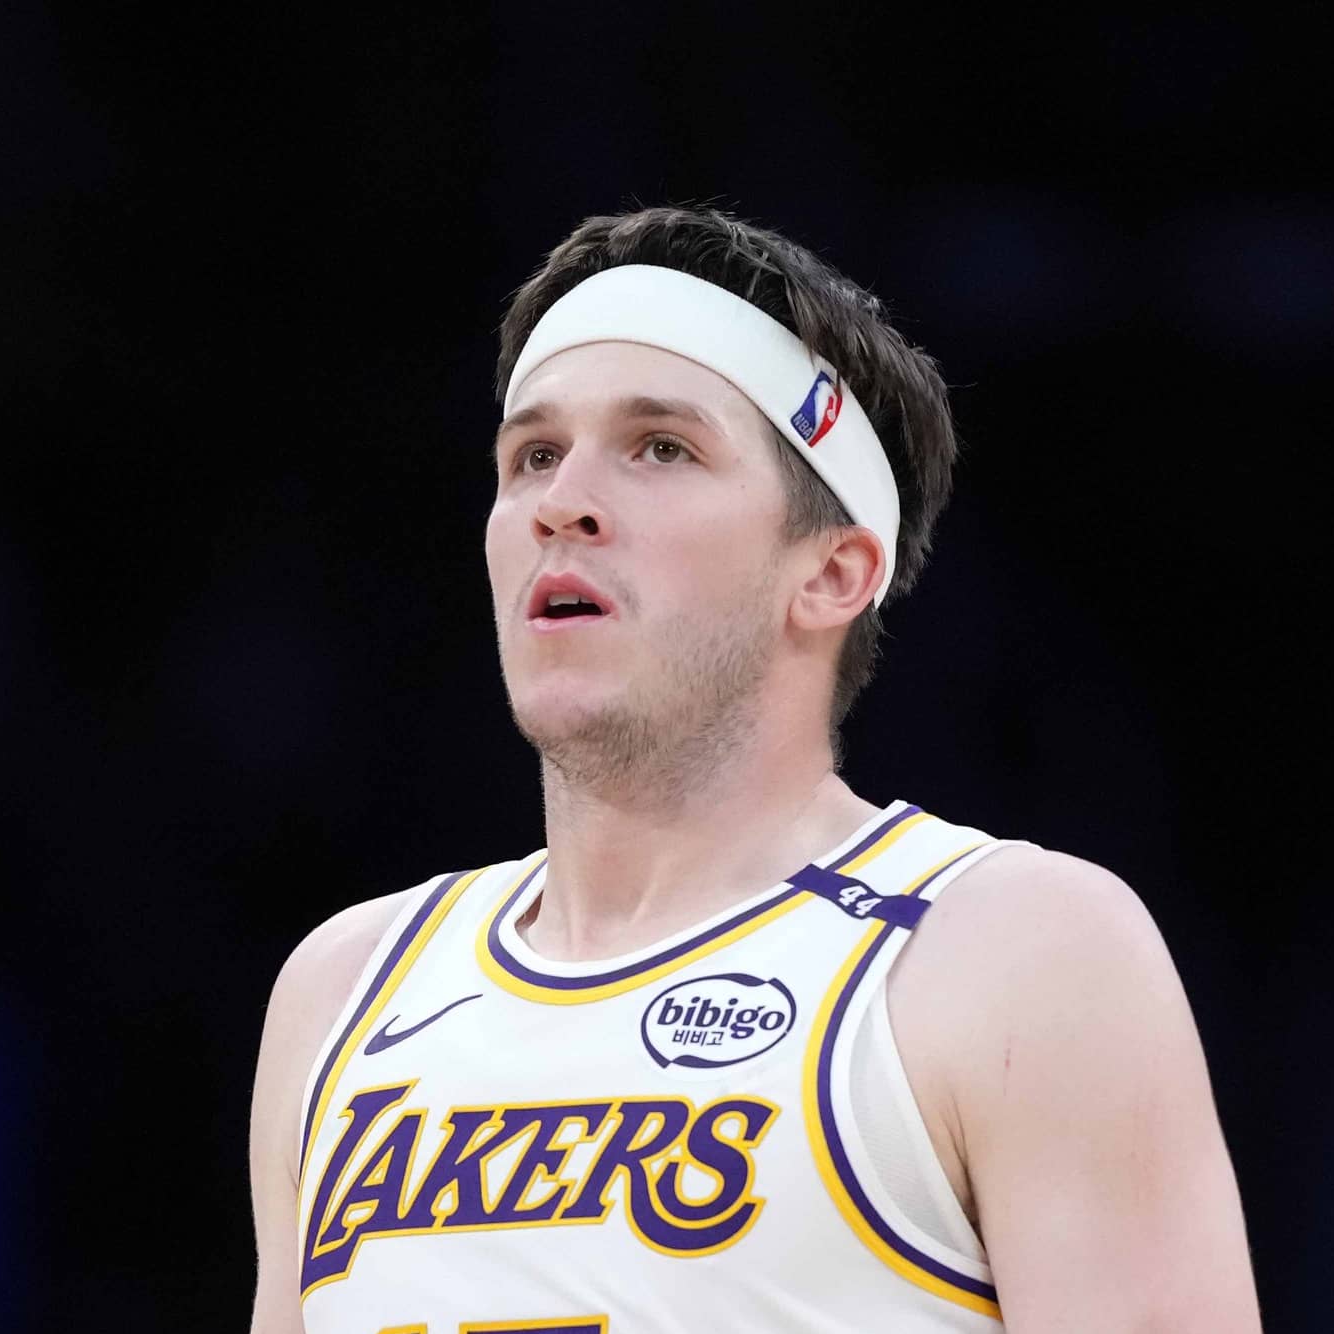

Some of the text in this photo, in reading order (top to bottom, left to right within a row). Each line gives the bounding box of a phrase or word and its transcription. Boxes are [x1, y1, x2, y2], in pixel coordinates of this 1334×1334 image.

[793, 412, 814, 439] NBA
[839, 885, 883, 916] 44
[657, 996, 785, 1039] bibigo
[672, 1029, 725, 1046] 비비고
[300, 1078, 782, 1304] LAKERS
